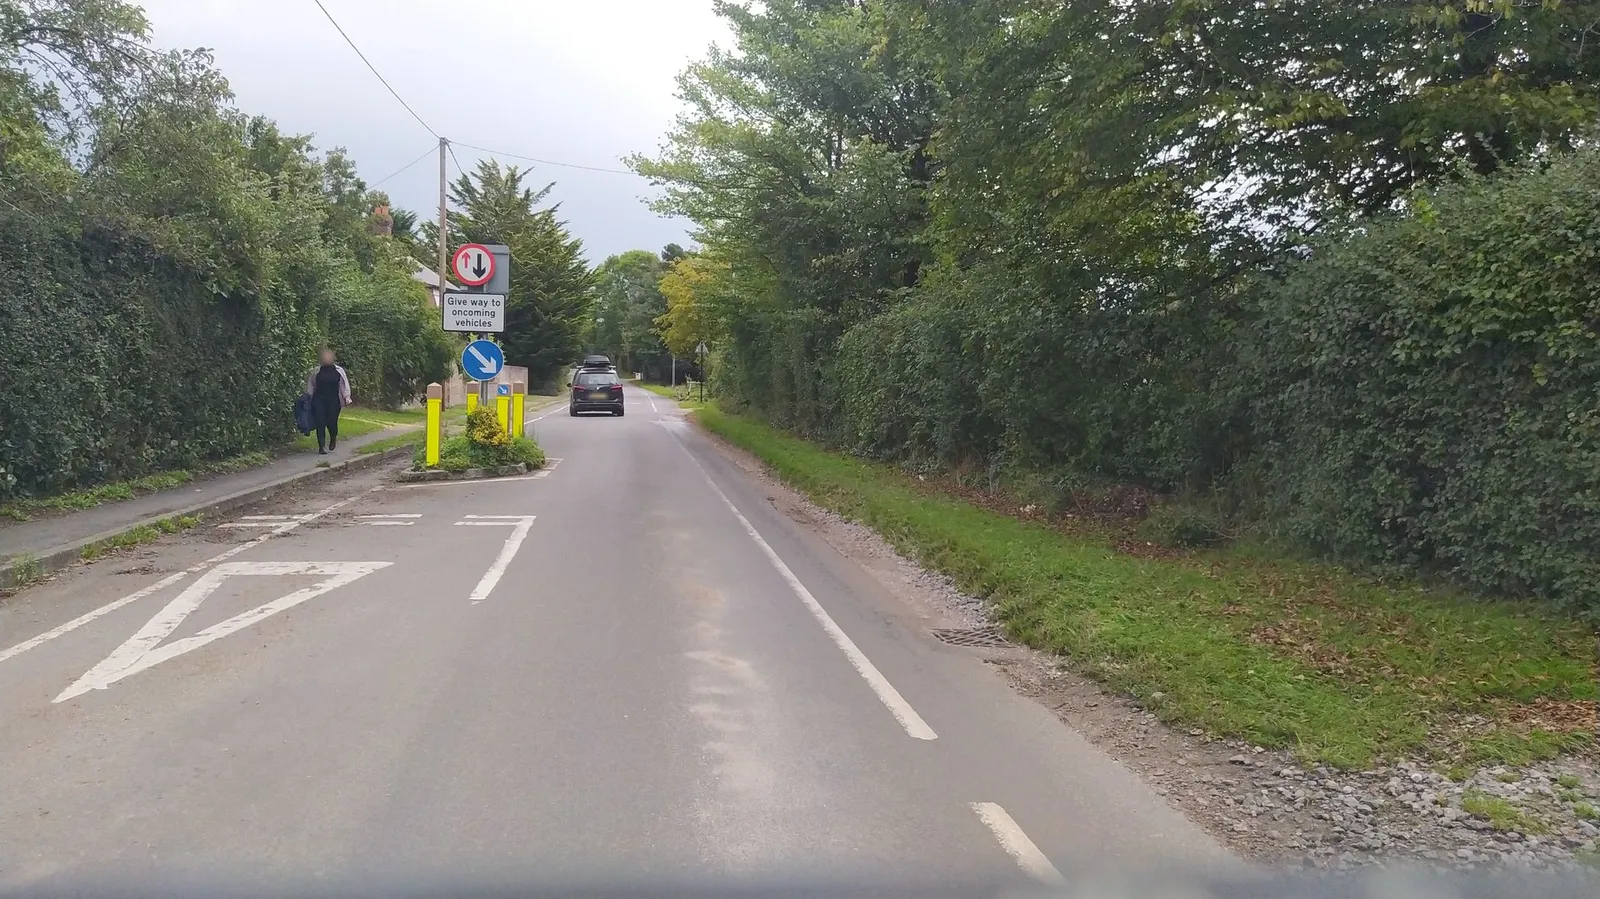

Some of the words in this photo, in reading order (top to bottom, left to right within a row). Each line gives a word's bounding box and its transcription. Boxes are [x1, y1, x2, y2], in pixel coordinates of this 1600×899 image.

[448, 297, 467, 305] Give
[452, 309, 496, 318] oncoming
[456, 319, 492, 327] vehicles
